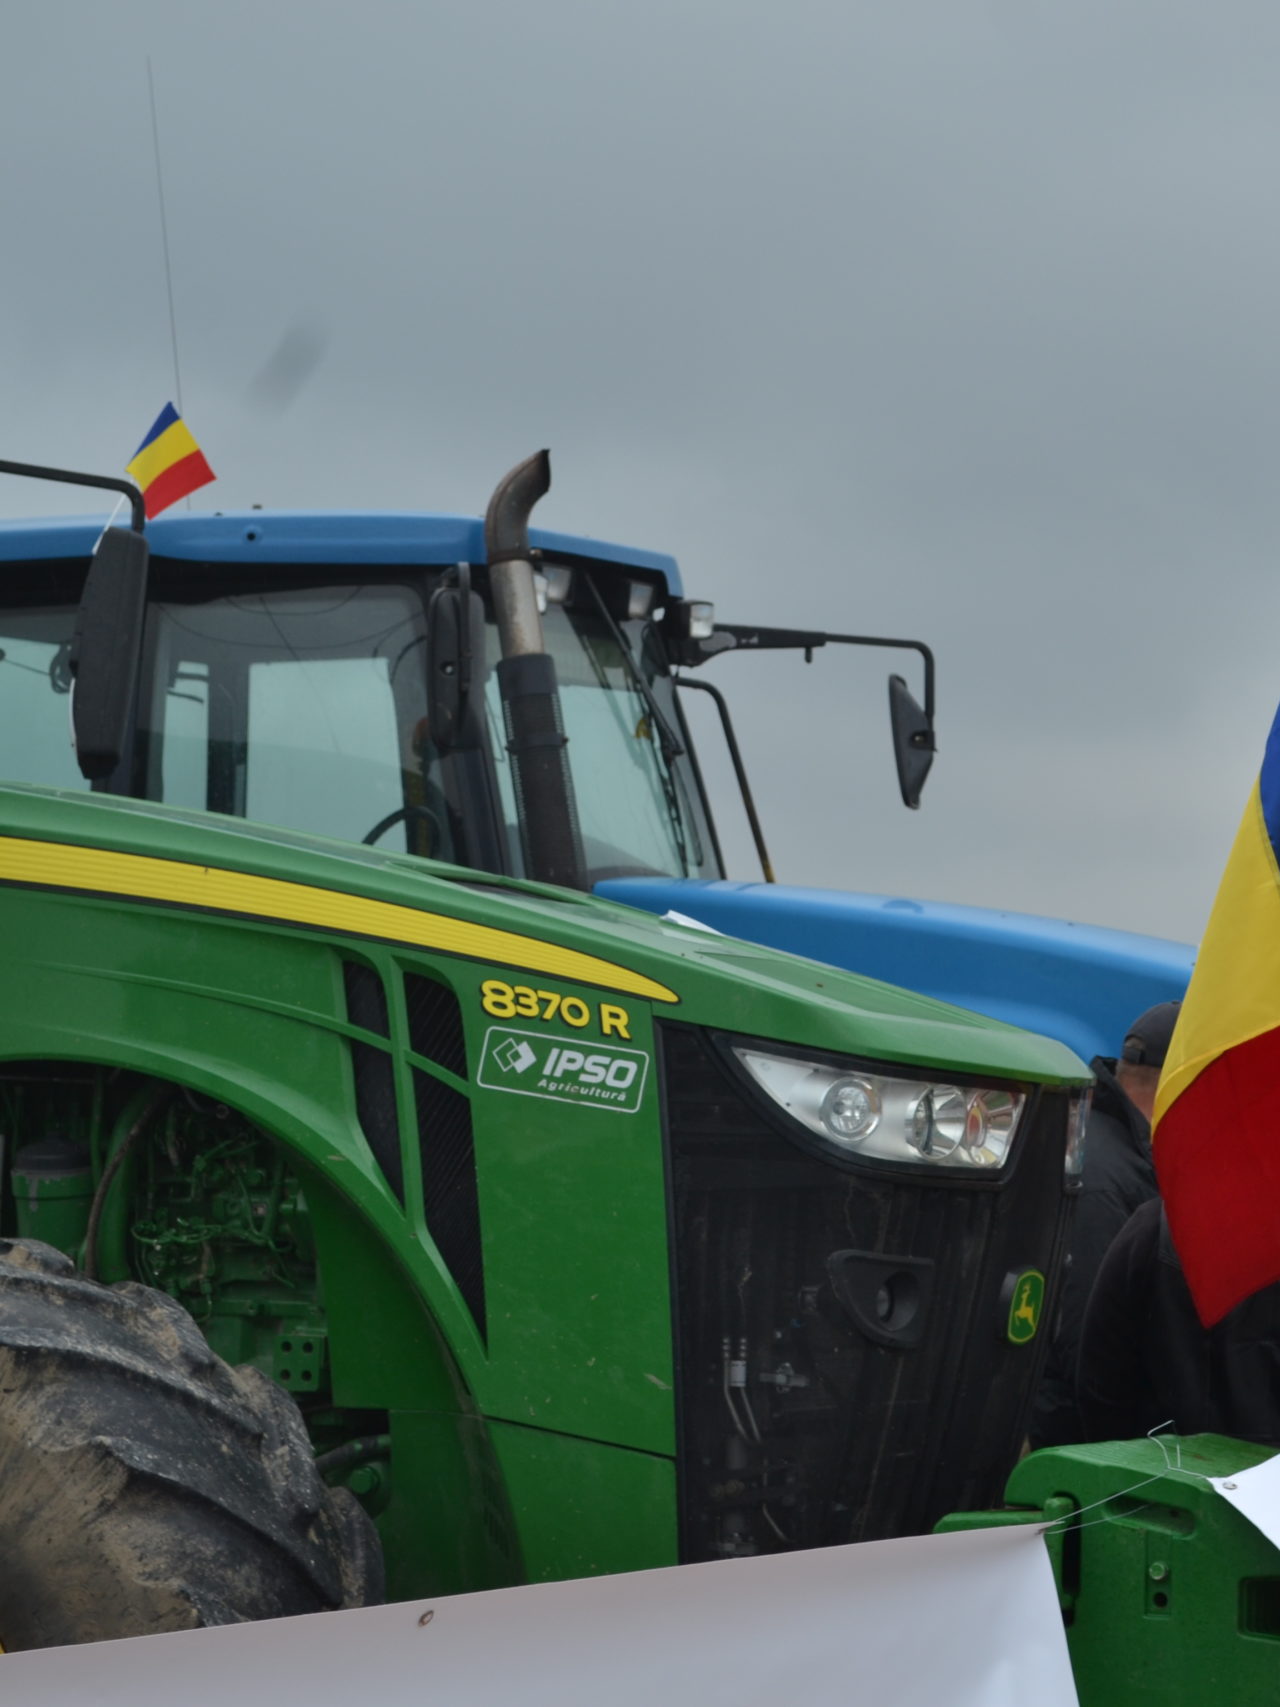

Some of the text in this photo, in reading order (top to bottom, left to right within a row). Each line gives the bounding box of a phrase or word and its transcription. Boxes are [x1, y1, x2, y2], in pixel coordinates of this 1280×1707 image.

[481, 979, 632, 1040] 8370 R
[542, 1047, 638, 1089] IPSO
[537, 1078, 627, 1102] Agricultură
